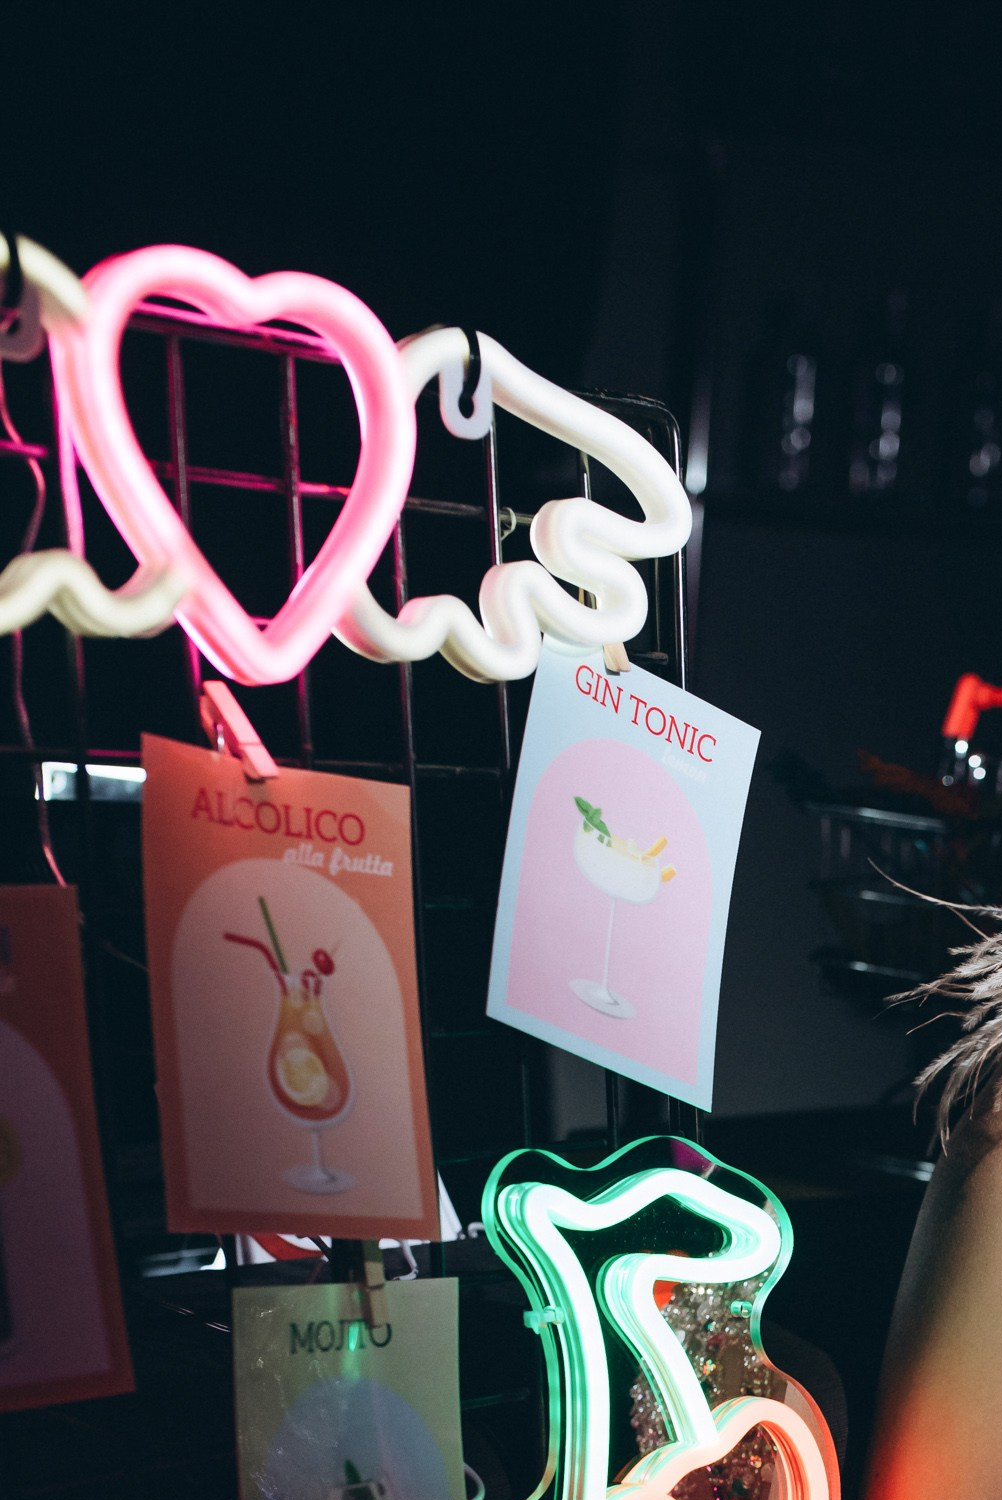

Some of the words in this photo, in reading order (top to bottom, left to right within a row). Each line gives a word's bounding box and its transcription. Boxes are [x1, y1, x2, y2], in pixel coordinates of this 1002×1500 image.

[575, 665, 624, 714] GIN
[629, 694, 717, 763] TONIC
[190, 787, 366, 846] ALCOLICO
[283, 842, 325, 868] alla
[328, 846, 394, 877] frutta
